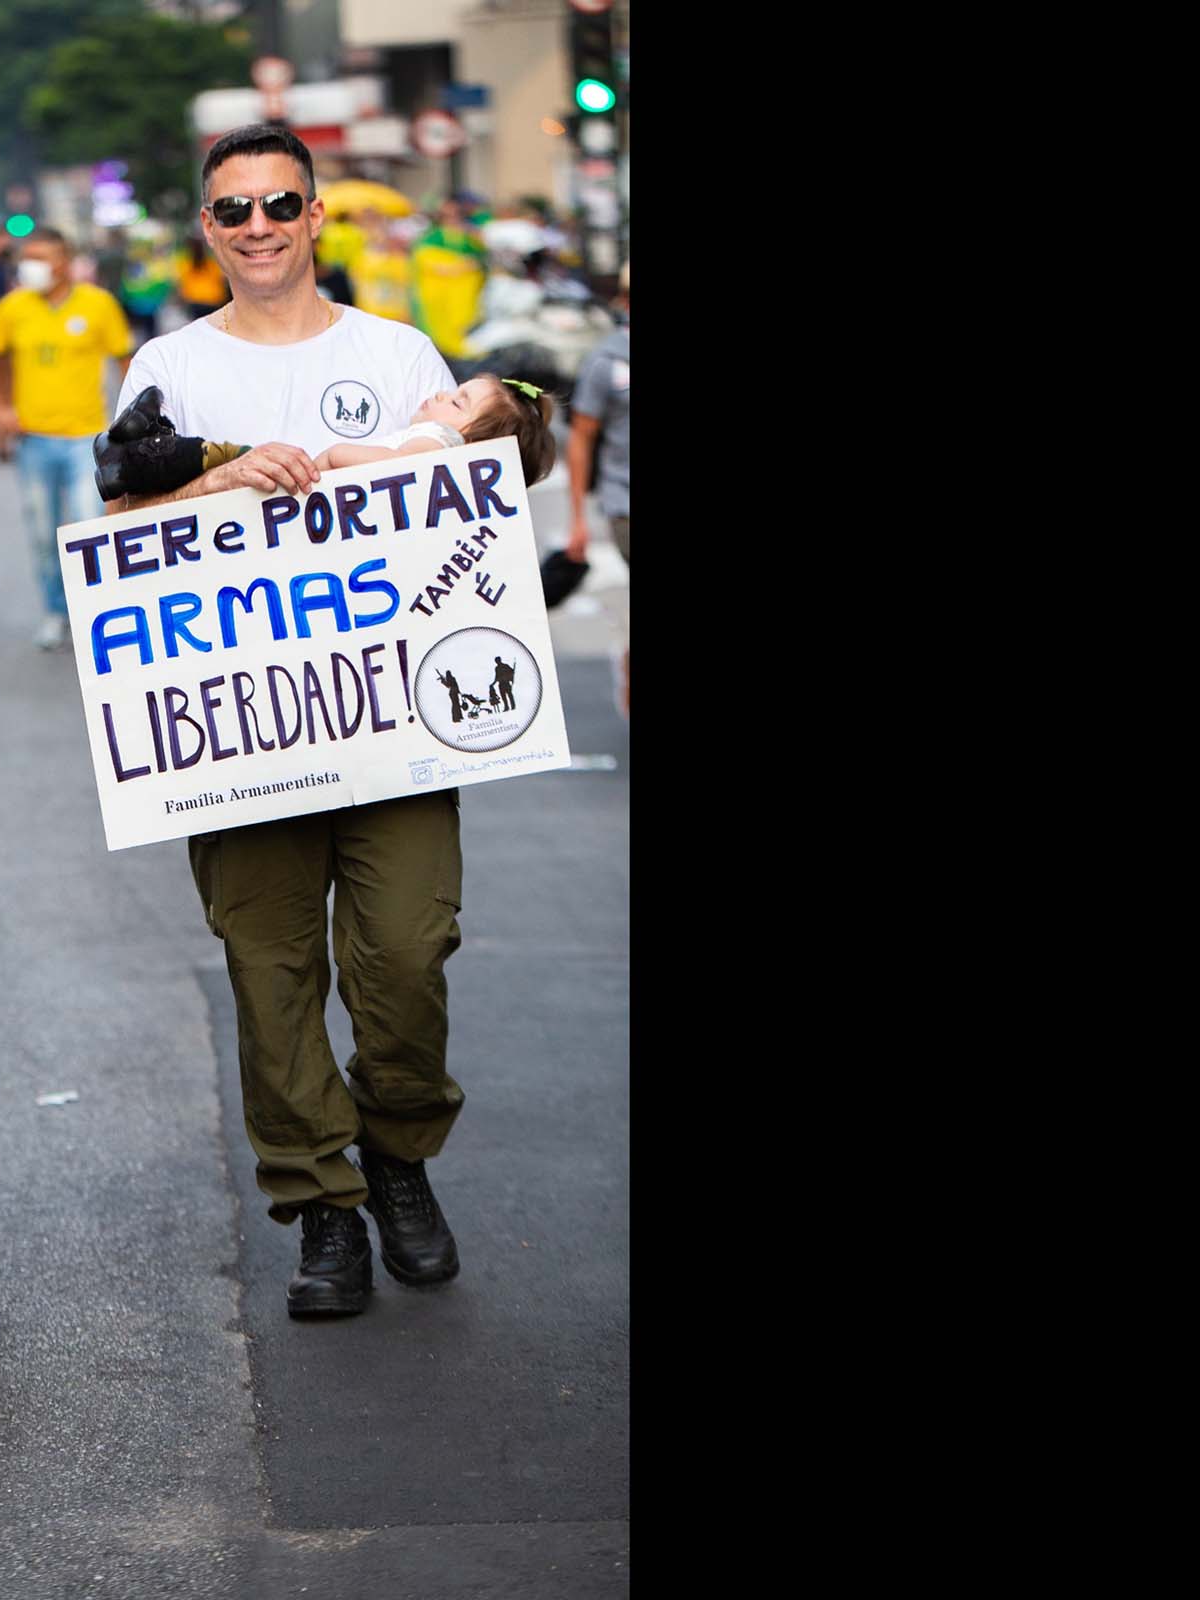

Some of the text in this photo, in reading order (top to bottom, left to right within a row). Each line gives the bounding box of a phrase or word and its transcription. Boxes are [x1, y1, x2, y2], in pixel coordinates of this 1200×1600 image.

[65, 457, 518, 587] TER e PORTAR
[90, 557, 401, 676] ARMAS
[409, 525, 499, 617] TAMBÉM
[475, 571, 507, 607] É
[101, 639, 414, 783] LIBERDADE!
[456, 722, 519, 743] Armamentista
[164, 770, 341, 815] Família Armamentista
